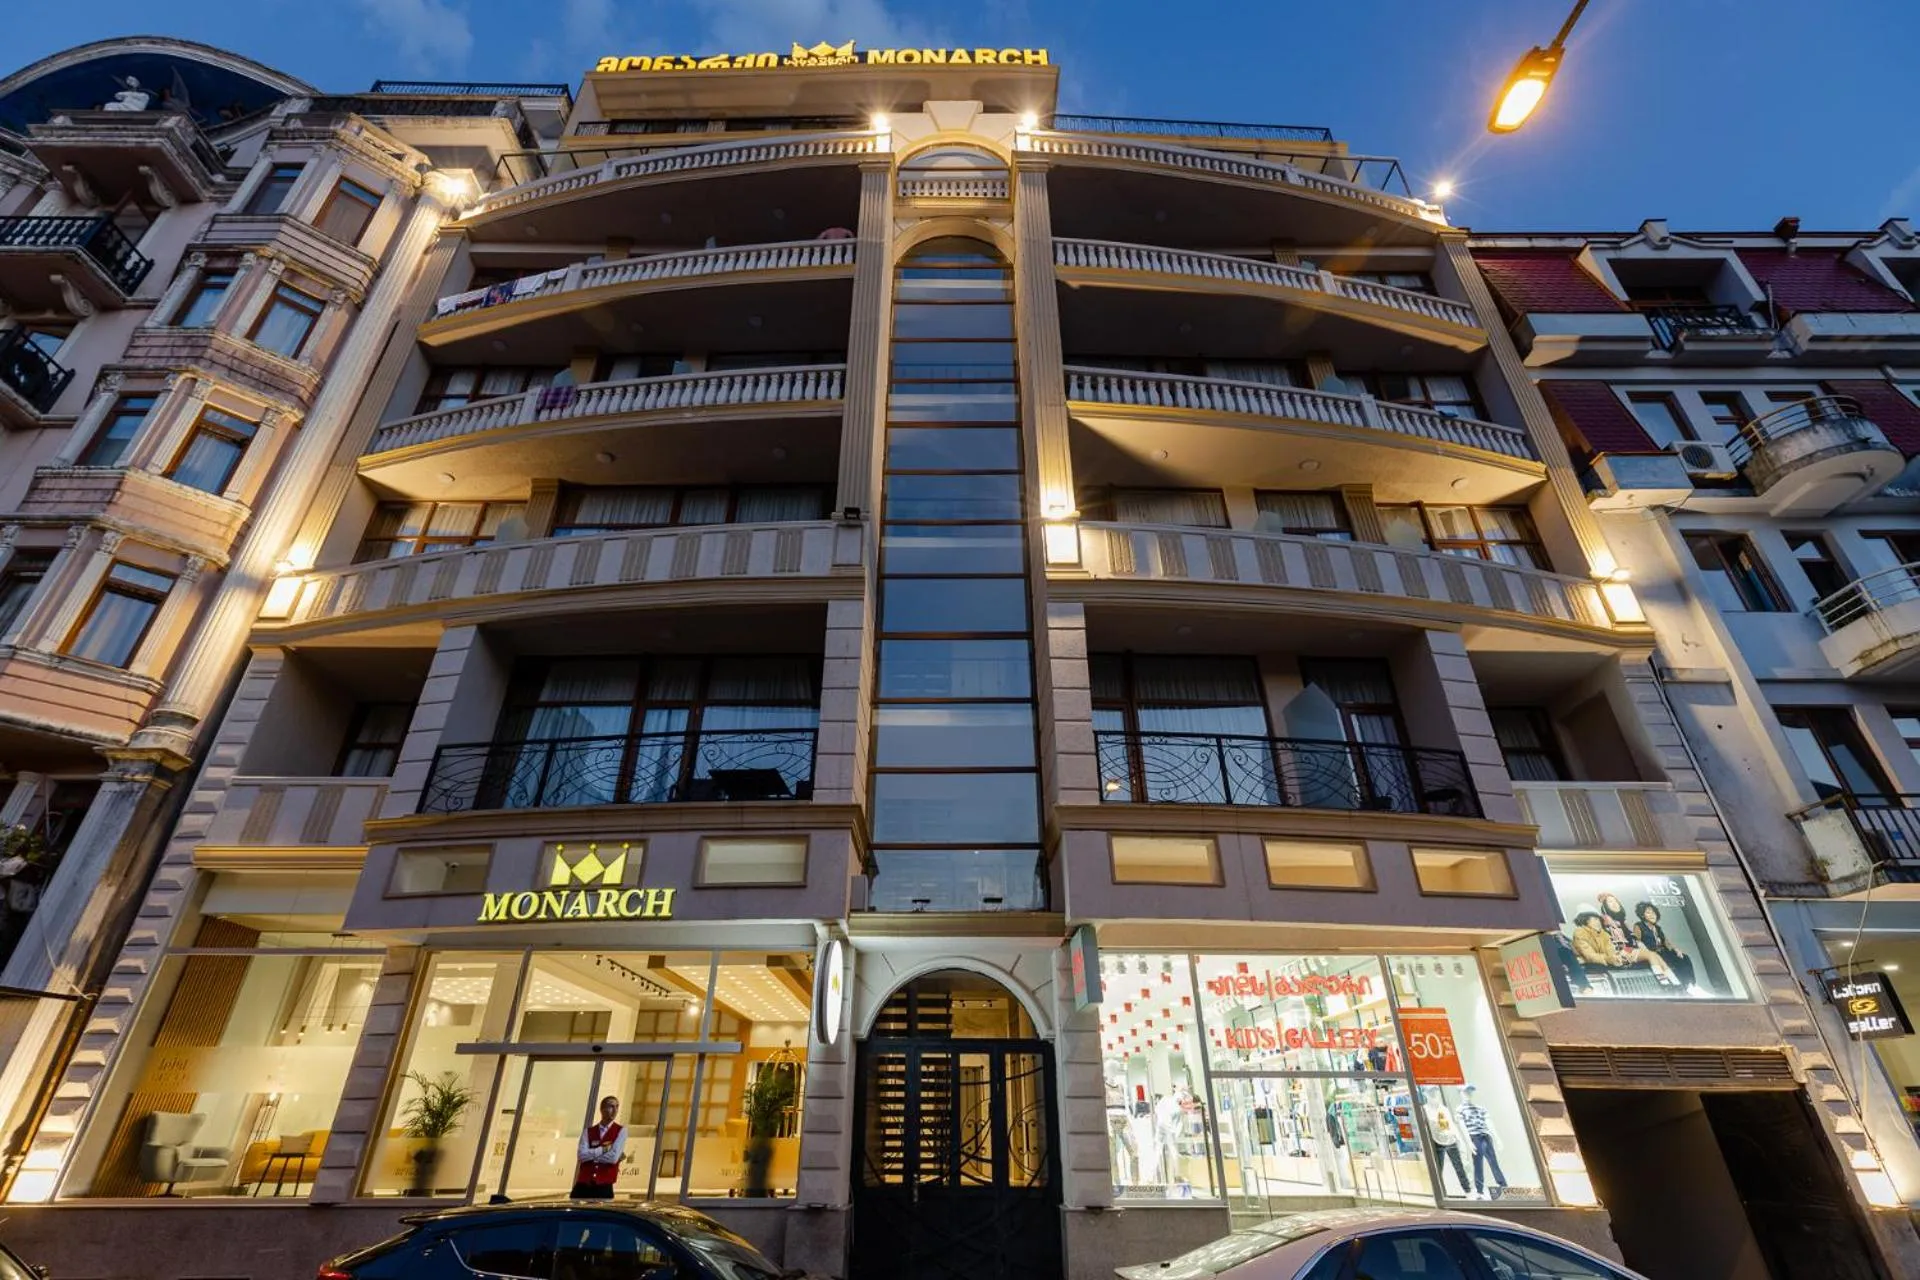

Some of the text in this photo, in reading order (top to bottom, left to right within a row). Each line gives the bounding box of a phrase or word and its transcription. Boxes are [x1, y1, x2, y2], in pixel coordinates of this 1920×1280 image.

[867, 48, 1048, 66] MONARCH
[477, 888, 677, 921] MONARCH
[1225, 1027, 1378, 1049] KID'S GALLERY
